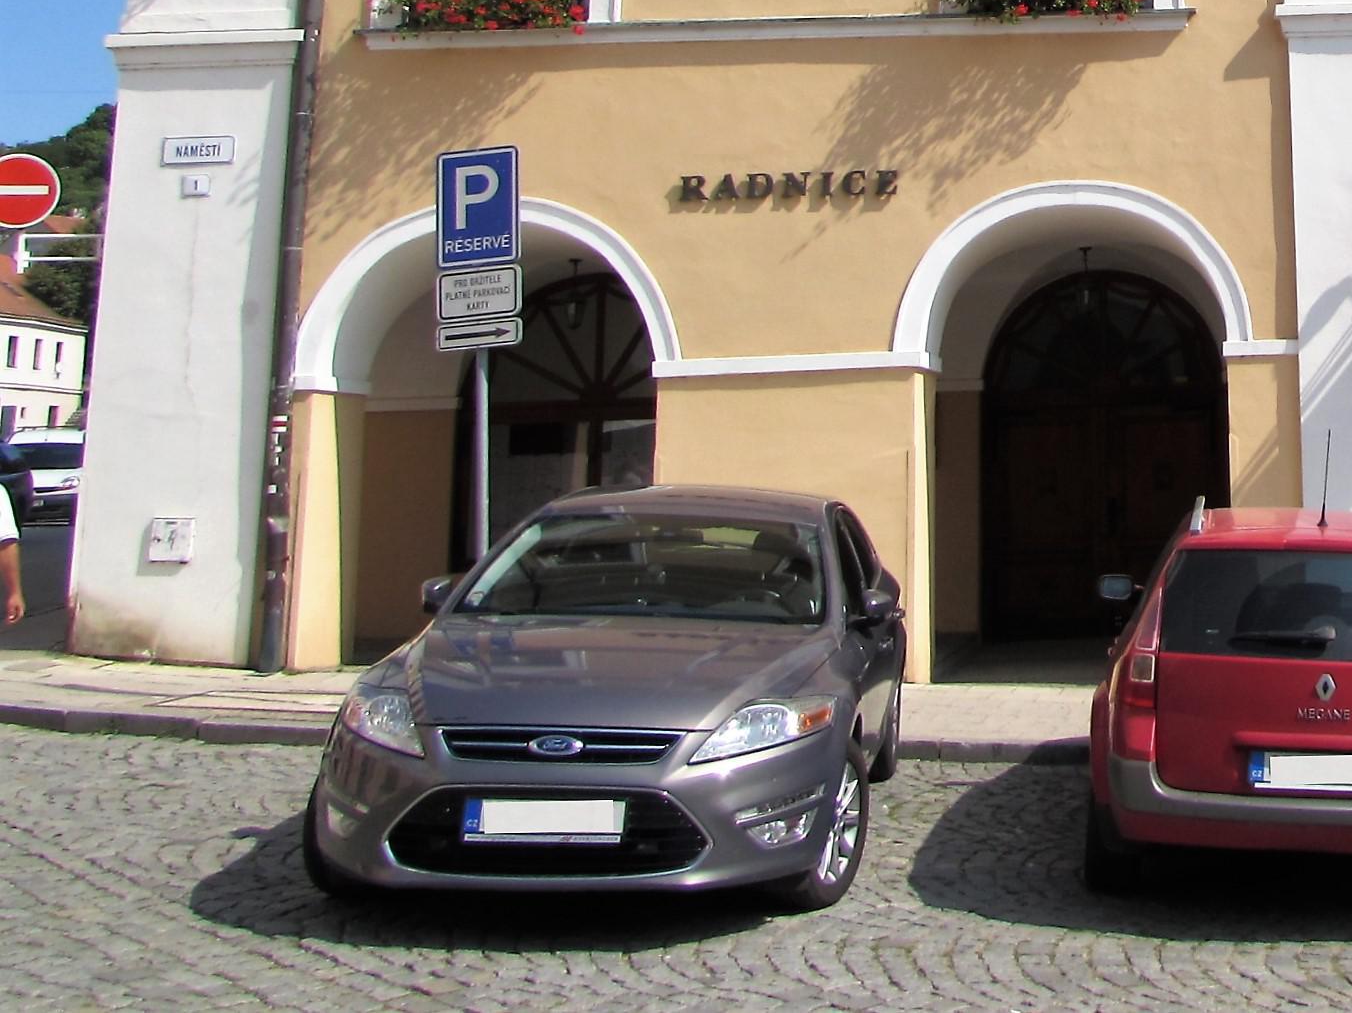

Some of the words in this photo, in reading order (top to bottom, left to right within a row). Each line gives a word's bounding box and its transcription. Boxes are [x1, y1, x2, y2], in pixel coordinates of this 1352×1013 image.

[176, 142, 221, 157] NÁMĚSTÍ
[679, 170, 898, 201] RADNICE
[455, 164, 500, 230] P
[445, 231, 511, 254] RÉSERVÉ
[454, 279, 468, 288] PRO
[467, 301, 489, 311] KARTY
[1297, 707, 1351, 720] MEGANE
[466, 819, 478, 827] CZ
